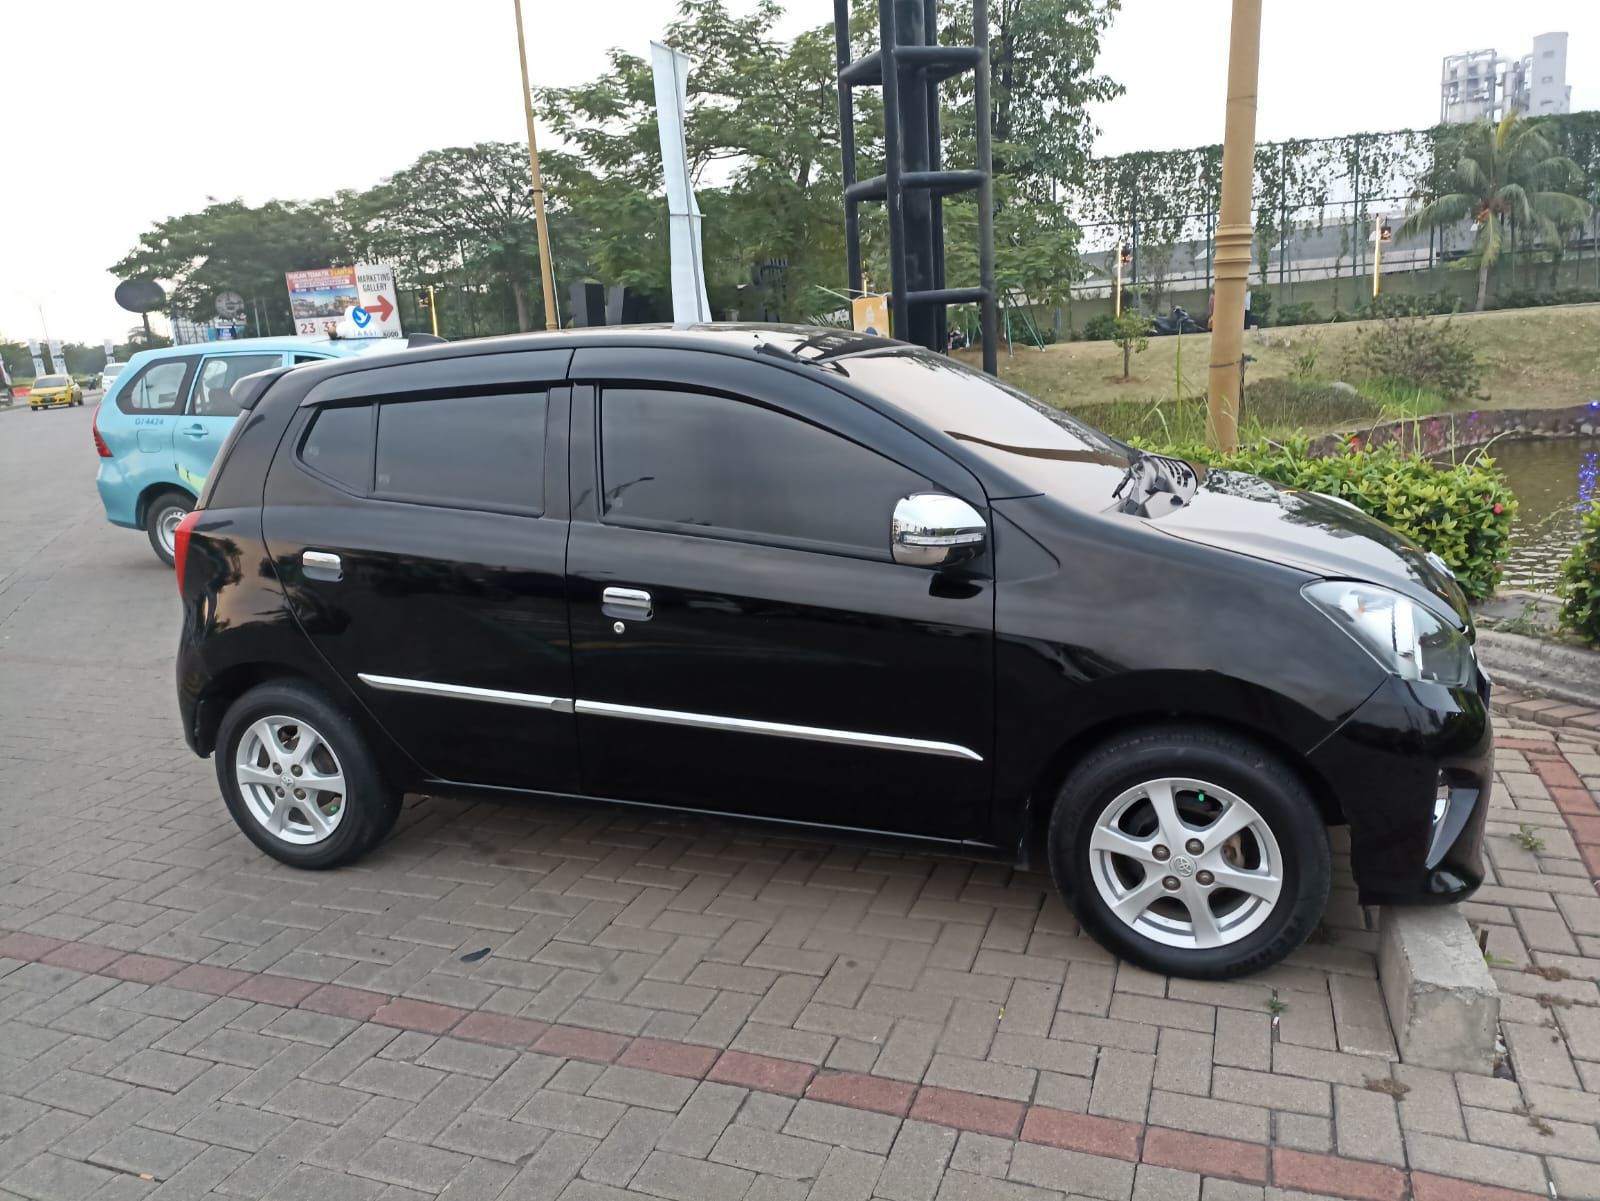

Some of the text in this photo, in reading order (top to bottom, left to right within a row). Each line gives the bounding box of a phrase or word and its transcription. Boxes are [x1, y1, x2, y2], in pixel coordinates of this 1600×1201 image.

[358, 273, 391, 282] MARKETING
[362, 282, 388, 292] GALLERY
[300, 322, 316, 335] 23
